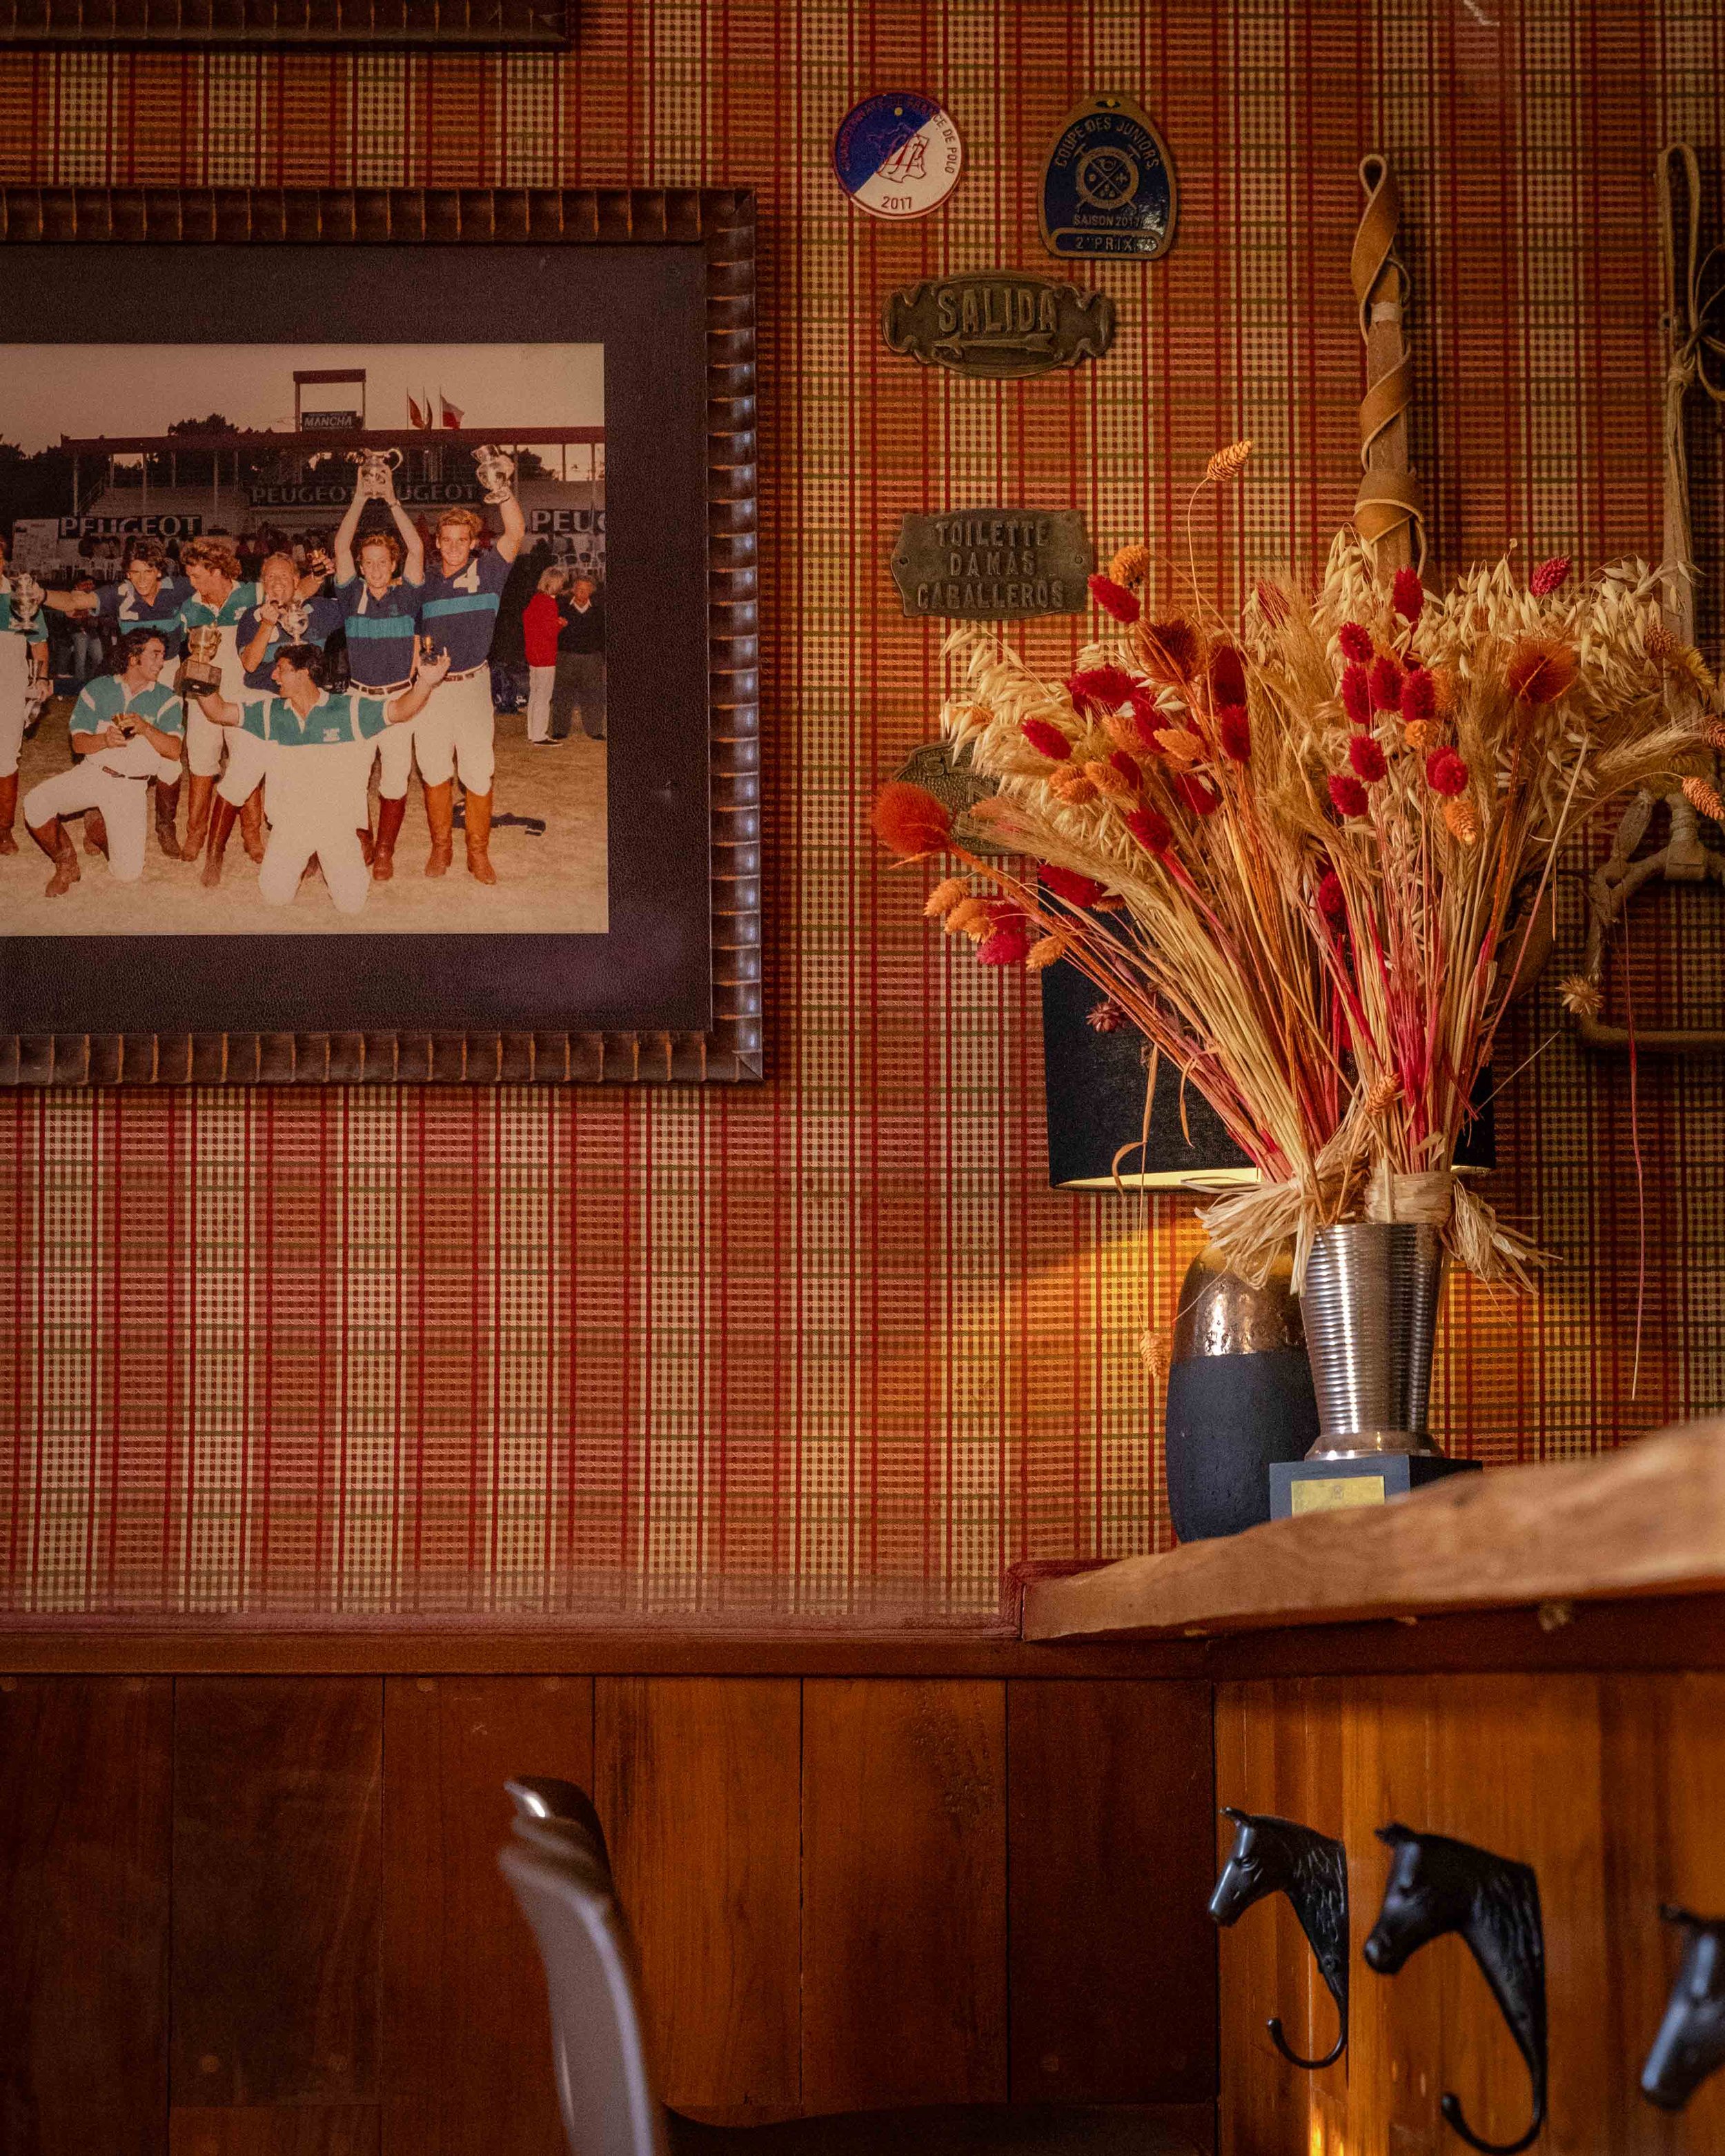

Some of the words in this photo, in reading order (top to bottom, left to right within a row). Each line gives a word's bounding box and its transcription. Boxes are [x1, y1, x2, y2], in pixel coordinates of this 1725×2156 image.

[943, 128, 955, 144] DE
[1054, 126, 1086, 168] COUPE
[1085, 117, 1112, 132] DES
[1116, 120, 1160, 170] JUNIORS
[945, 147, 958, 174] POLO
[880, 196, 912, 210] 2017
[1074, 214, 1114, 226] SAISON
[1095, 237, 1133, 250] PRIX
[937, 287, 1057, 333] SALIDA
[304, 415, 353, 427] MANCHA
[935, 520, 1047, 547] TOILETTE
[453, 558, 480, 593] 4
[949, 551, 1035, 577] DAMAS
[118, 580, 139, 620] 2
[918, 580, 1065, 609] CABALLEROS
